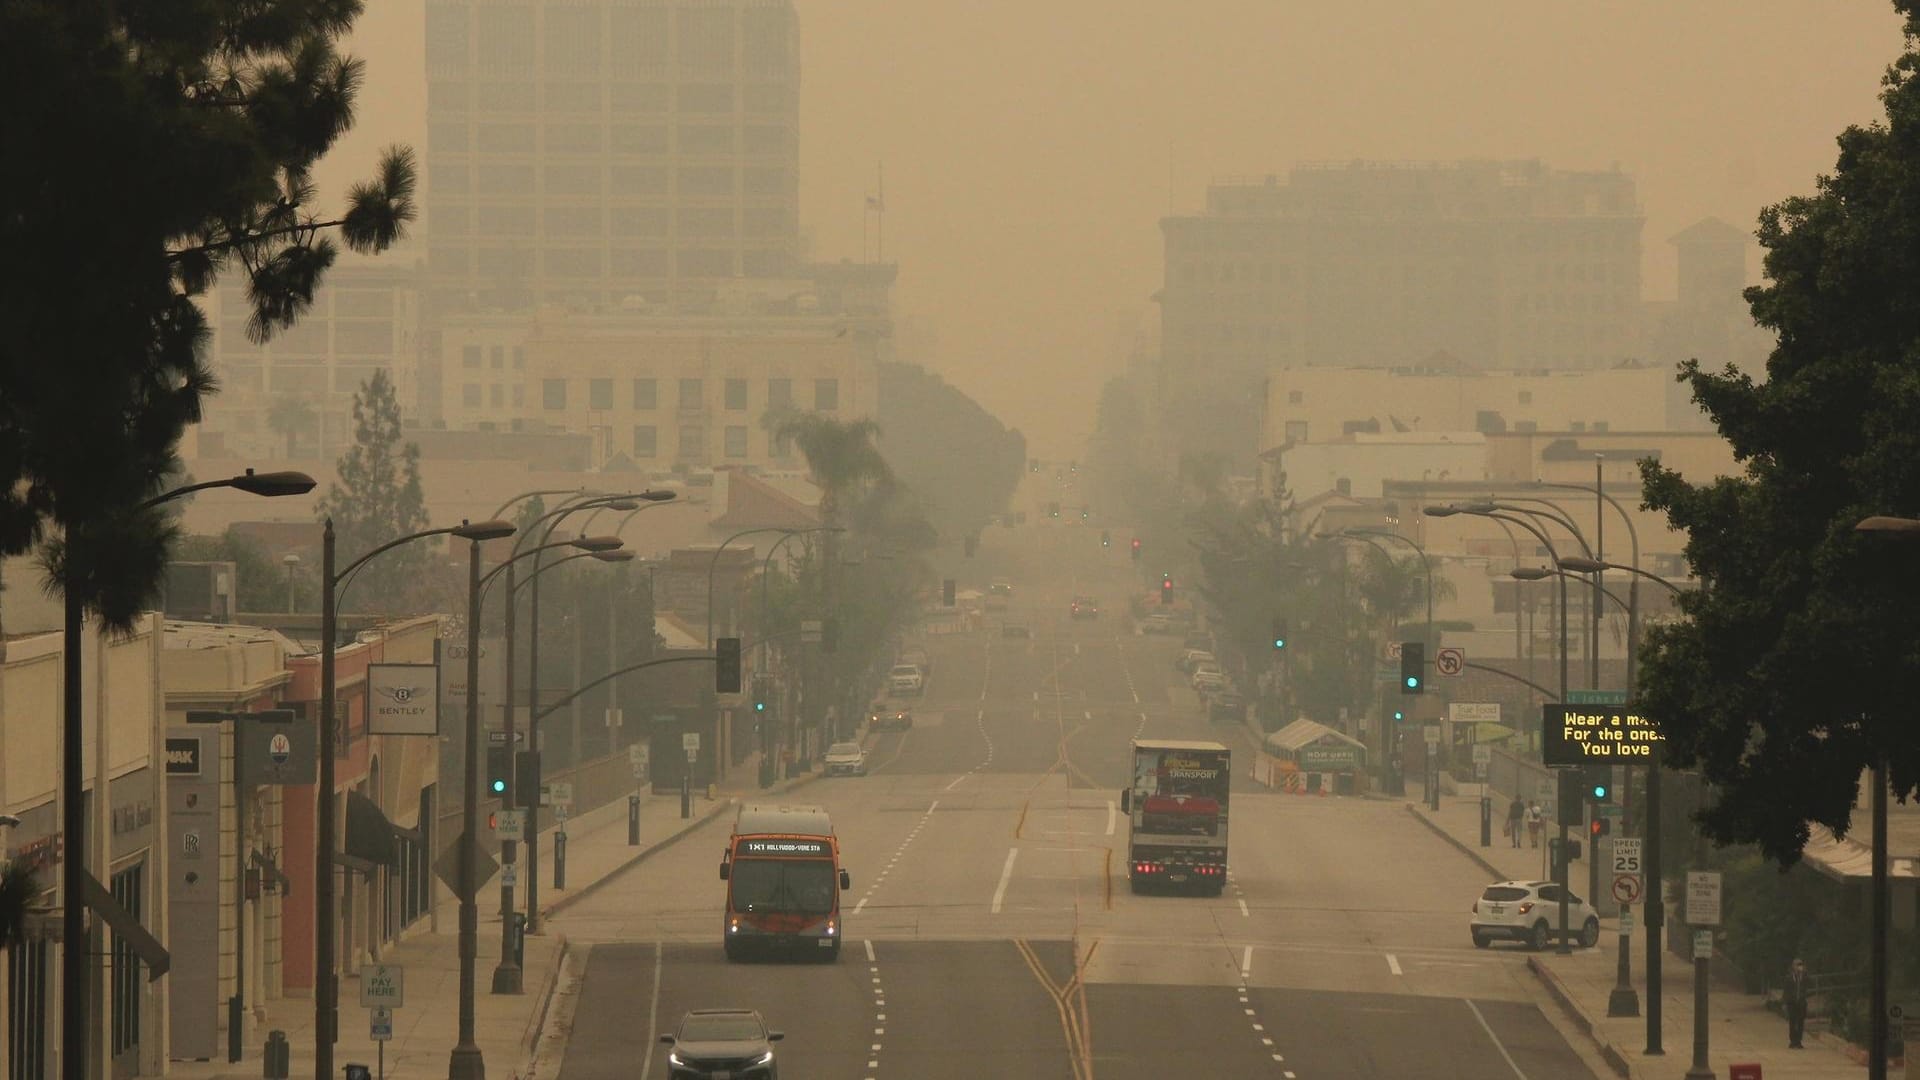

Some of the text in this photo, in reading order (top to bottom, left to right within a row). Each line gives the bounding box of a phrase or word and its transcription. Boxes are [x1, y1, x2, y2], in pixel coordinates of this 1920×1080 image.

[378, 707, 427, 715] BENTLEY
[1565, 712, 1605, 726] Wear
[1611, 715, 1620, 726] a
[1564, 727, 1592, 740] For
[1598, 727, 1623, 740] the
[1581, 742, 1650, 755] You love
[1168, 769, 1217, 780] TRANSPORT
[1615, 857, 1639, 871] 25
[371, 978, 392, 986] PAY
[367, 987, 396, 996] HERE
